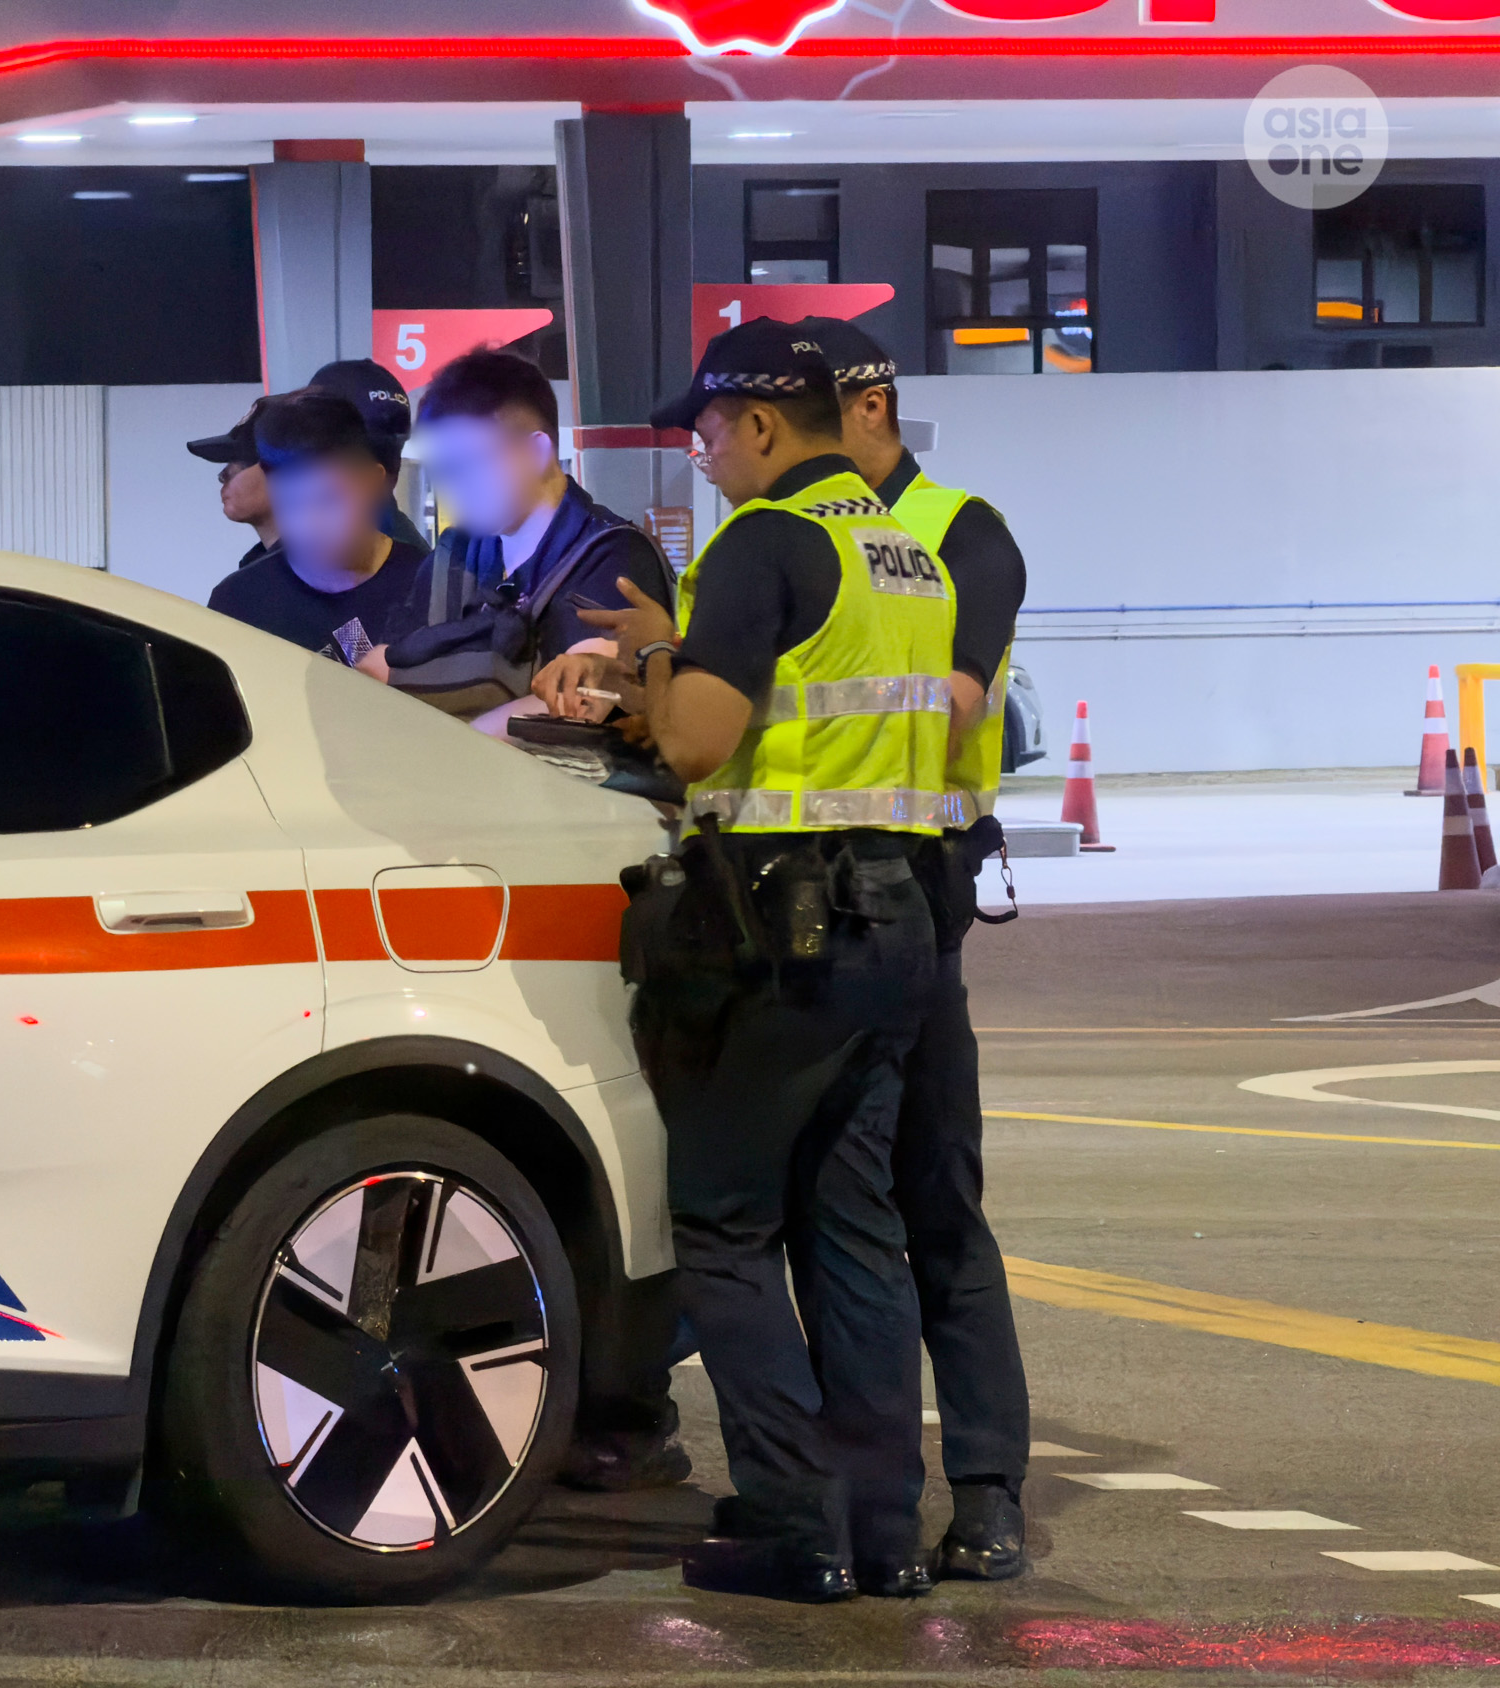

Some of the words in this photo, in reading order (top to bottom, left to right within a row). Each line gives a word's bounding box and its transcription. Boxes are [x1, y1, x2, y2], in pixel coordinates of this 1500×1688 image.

[719, 300, 742, 329] 1
[396, 324, 426, 370] 5
[368, 390, 409, 407] POLIC
